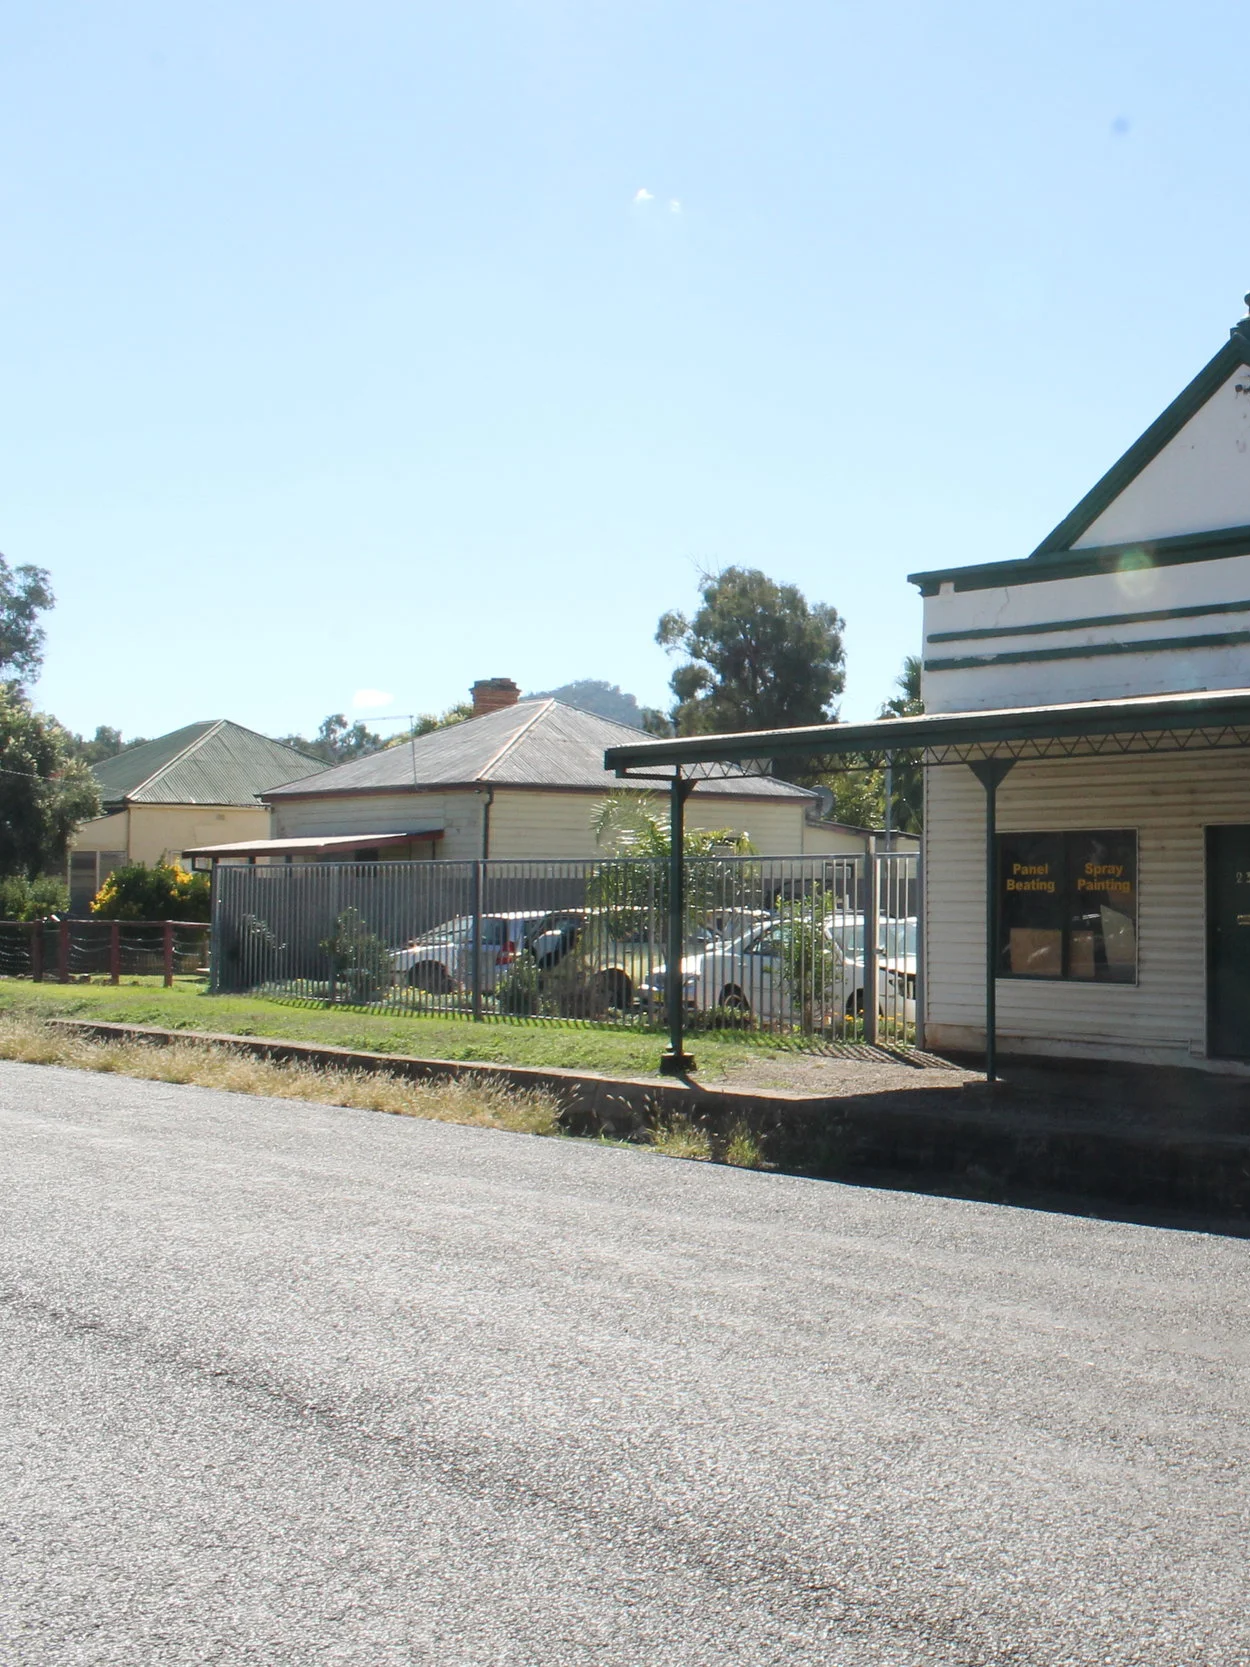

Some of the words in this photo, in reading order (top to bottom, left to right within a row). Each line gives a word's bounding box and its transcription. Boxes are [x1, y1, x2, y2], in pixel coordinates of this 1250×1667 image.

[1012, 863, 1048, 876] Panel
[1084, 862, 1124, 880] Spray
[1006, 879, 1056, 893] Beating
[1077, 879, 1131, 893] Painting
